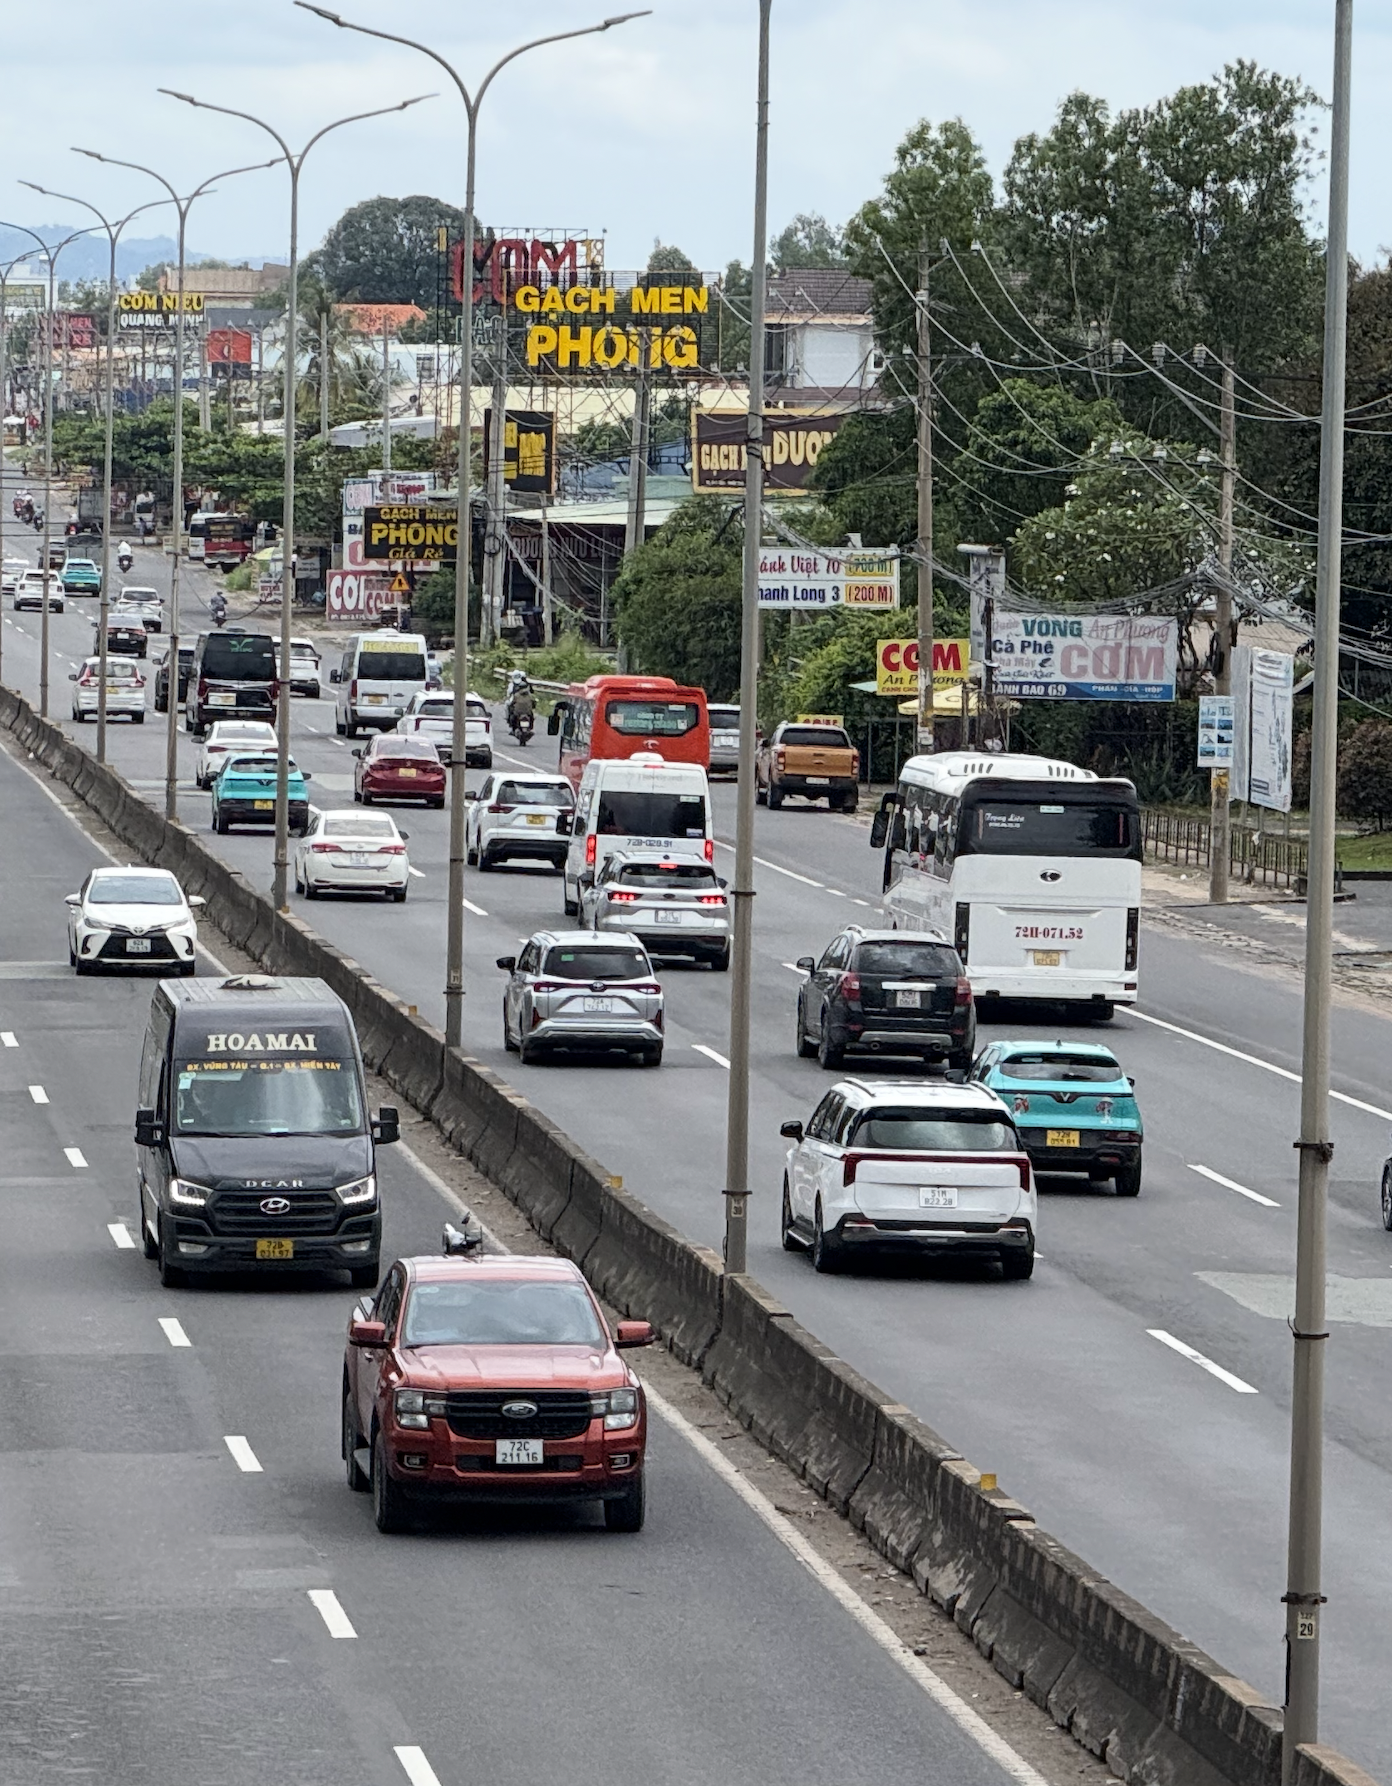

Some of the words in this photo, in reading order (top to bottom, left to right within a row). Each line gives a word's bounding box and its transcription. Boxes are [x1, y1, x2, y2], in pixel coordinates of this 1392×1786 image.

[631, 286, 709, 314] MEN
[425, 508, 457, 520] MEN
[371, 522, 458, 546] PHONG
[793, 586, 826, 604] Long
[831, 588, 840, 601] 3
[1020, 639, 1054, 654] Phê
[1060, 642, 1165, 681] CƠM
[1048, 683, 1067, 697] 69
[245, 1180, 304, 1188] DCAR
[509, 1441, 530, 1452] 72C
[501, 1452, 539, 1463] 211.16
